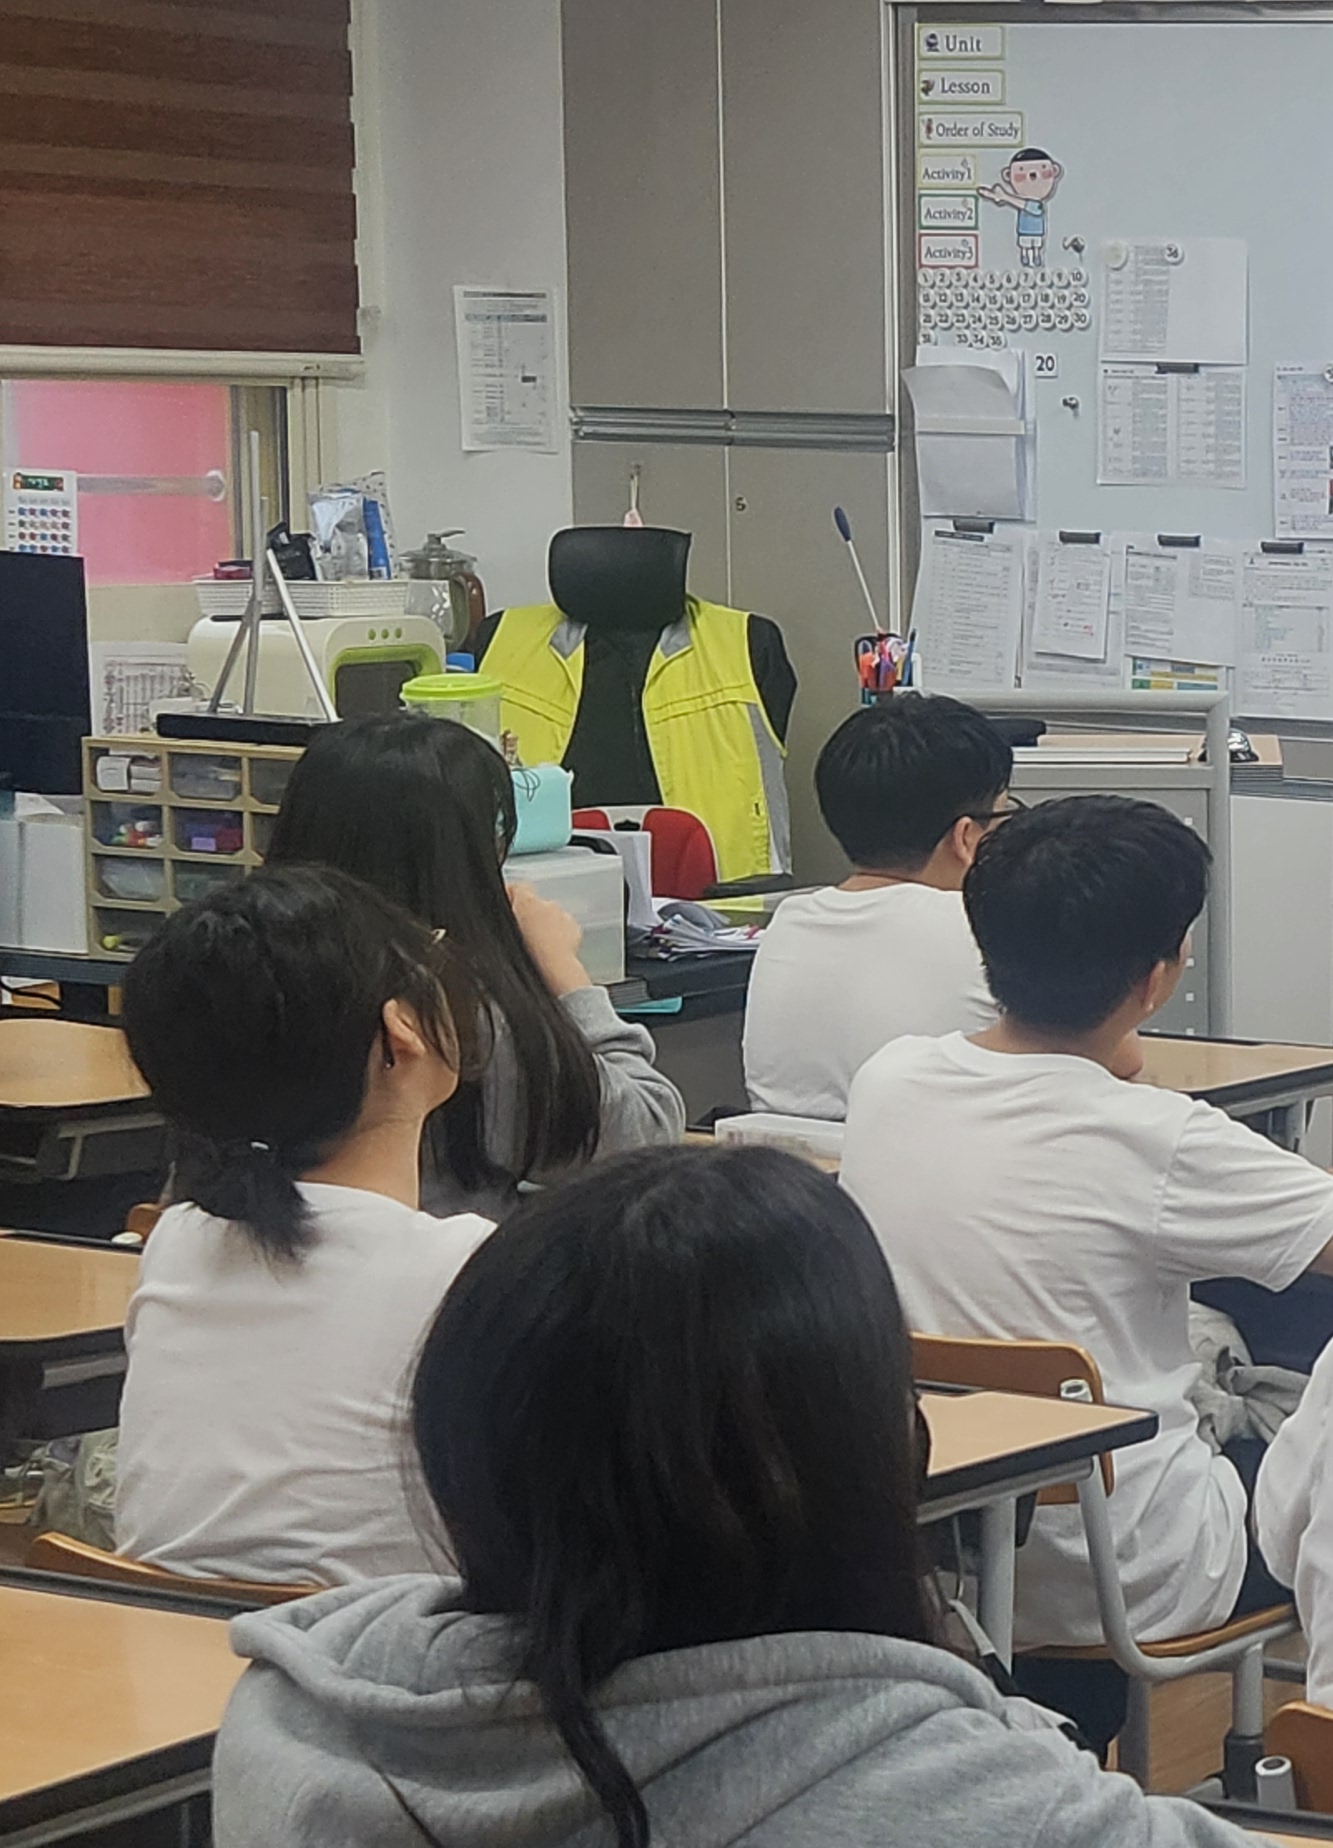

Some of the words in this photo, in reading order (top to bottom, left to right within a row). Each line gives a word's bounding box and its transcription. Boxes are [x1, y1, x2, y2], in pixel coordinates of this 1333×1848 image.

[945, 35, 982, 53] Unit
[940, 77, 991, 94] Lesson
[936, 121, 969, 138] Order
[972, 121, 985, 138] of
[987, 121, 1020, 139] Study
[1036, 356, 1055, 372] 20
